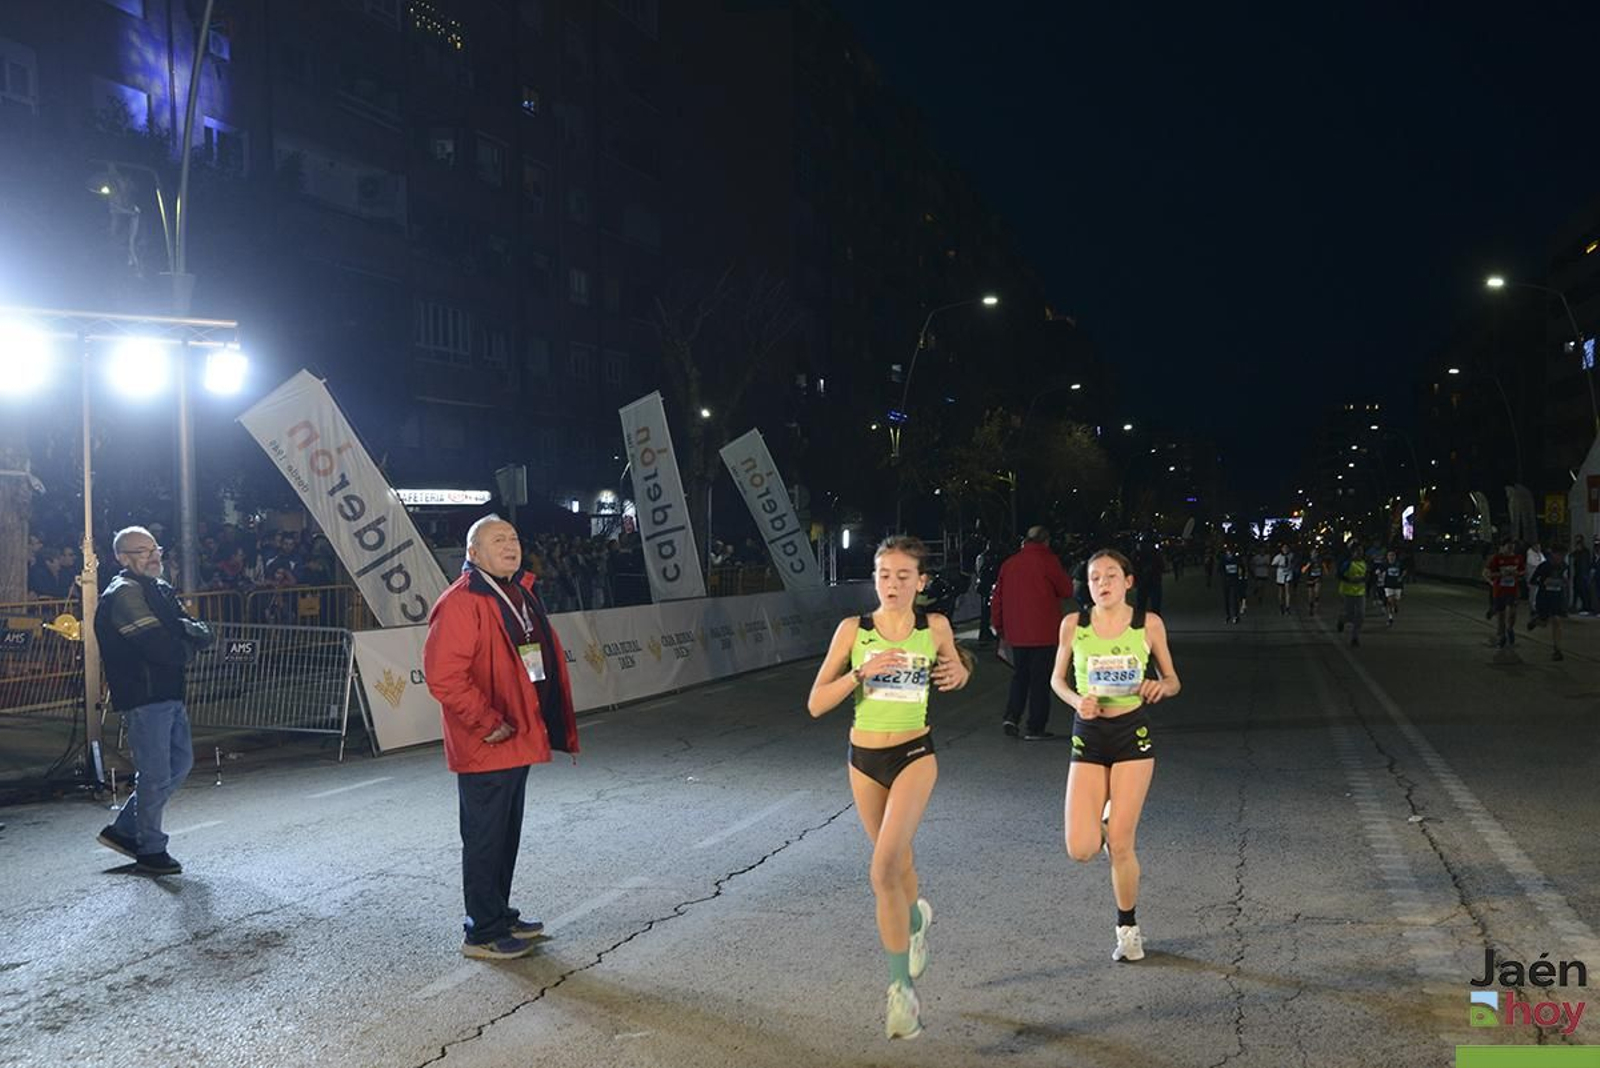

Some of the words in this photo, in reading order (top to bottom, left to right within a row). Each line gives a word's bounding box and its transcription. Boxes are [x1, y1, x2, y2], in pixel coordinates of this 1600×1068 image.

[401, 492, 445, 502] AFETERIA
[4, 633, 25, 643] AMS
[230, 643, 253, 653] AMS
[872, 671, 920, 684] 12278
